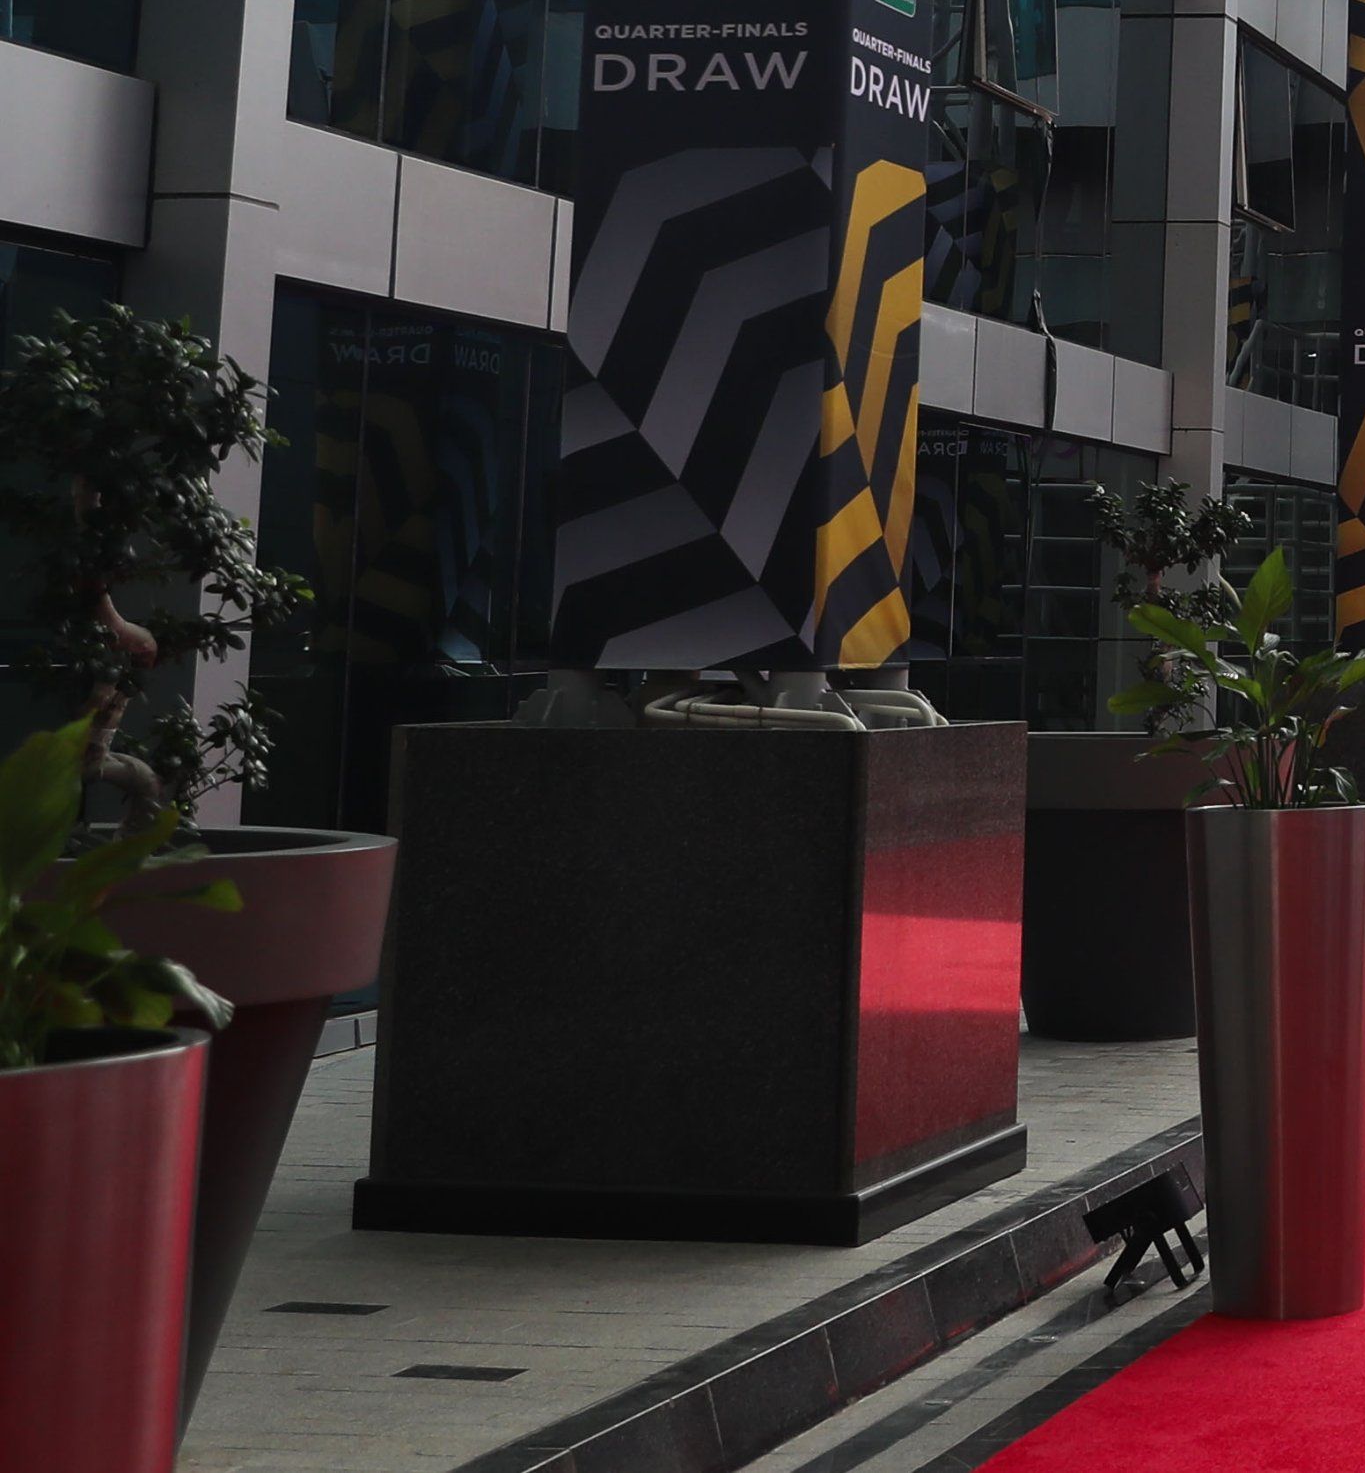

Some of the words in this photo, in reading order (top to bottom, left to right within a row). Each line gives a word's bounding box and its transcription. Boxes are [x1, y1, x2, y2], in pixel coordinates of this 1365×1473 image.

[595, 22, 809, 40] QUARTER-FINALS
[852, 28, 932, 74] QUARTER-FINALS
[593, 51, 808, 92] DRAW
[850, 56, 931, 123] DRAW
